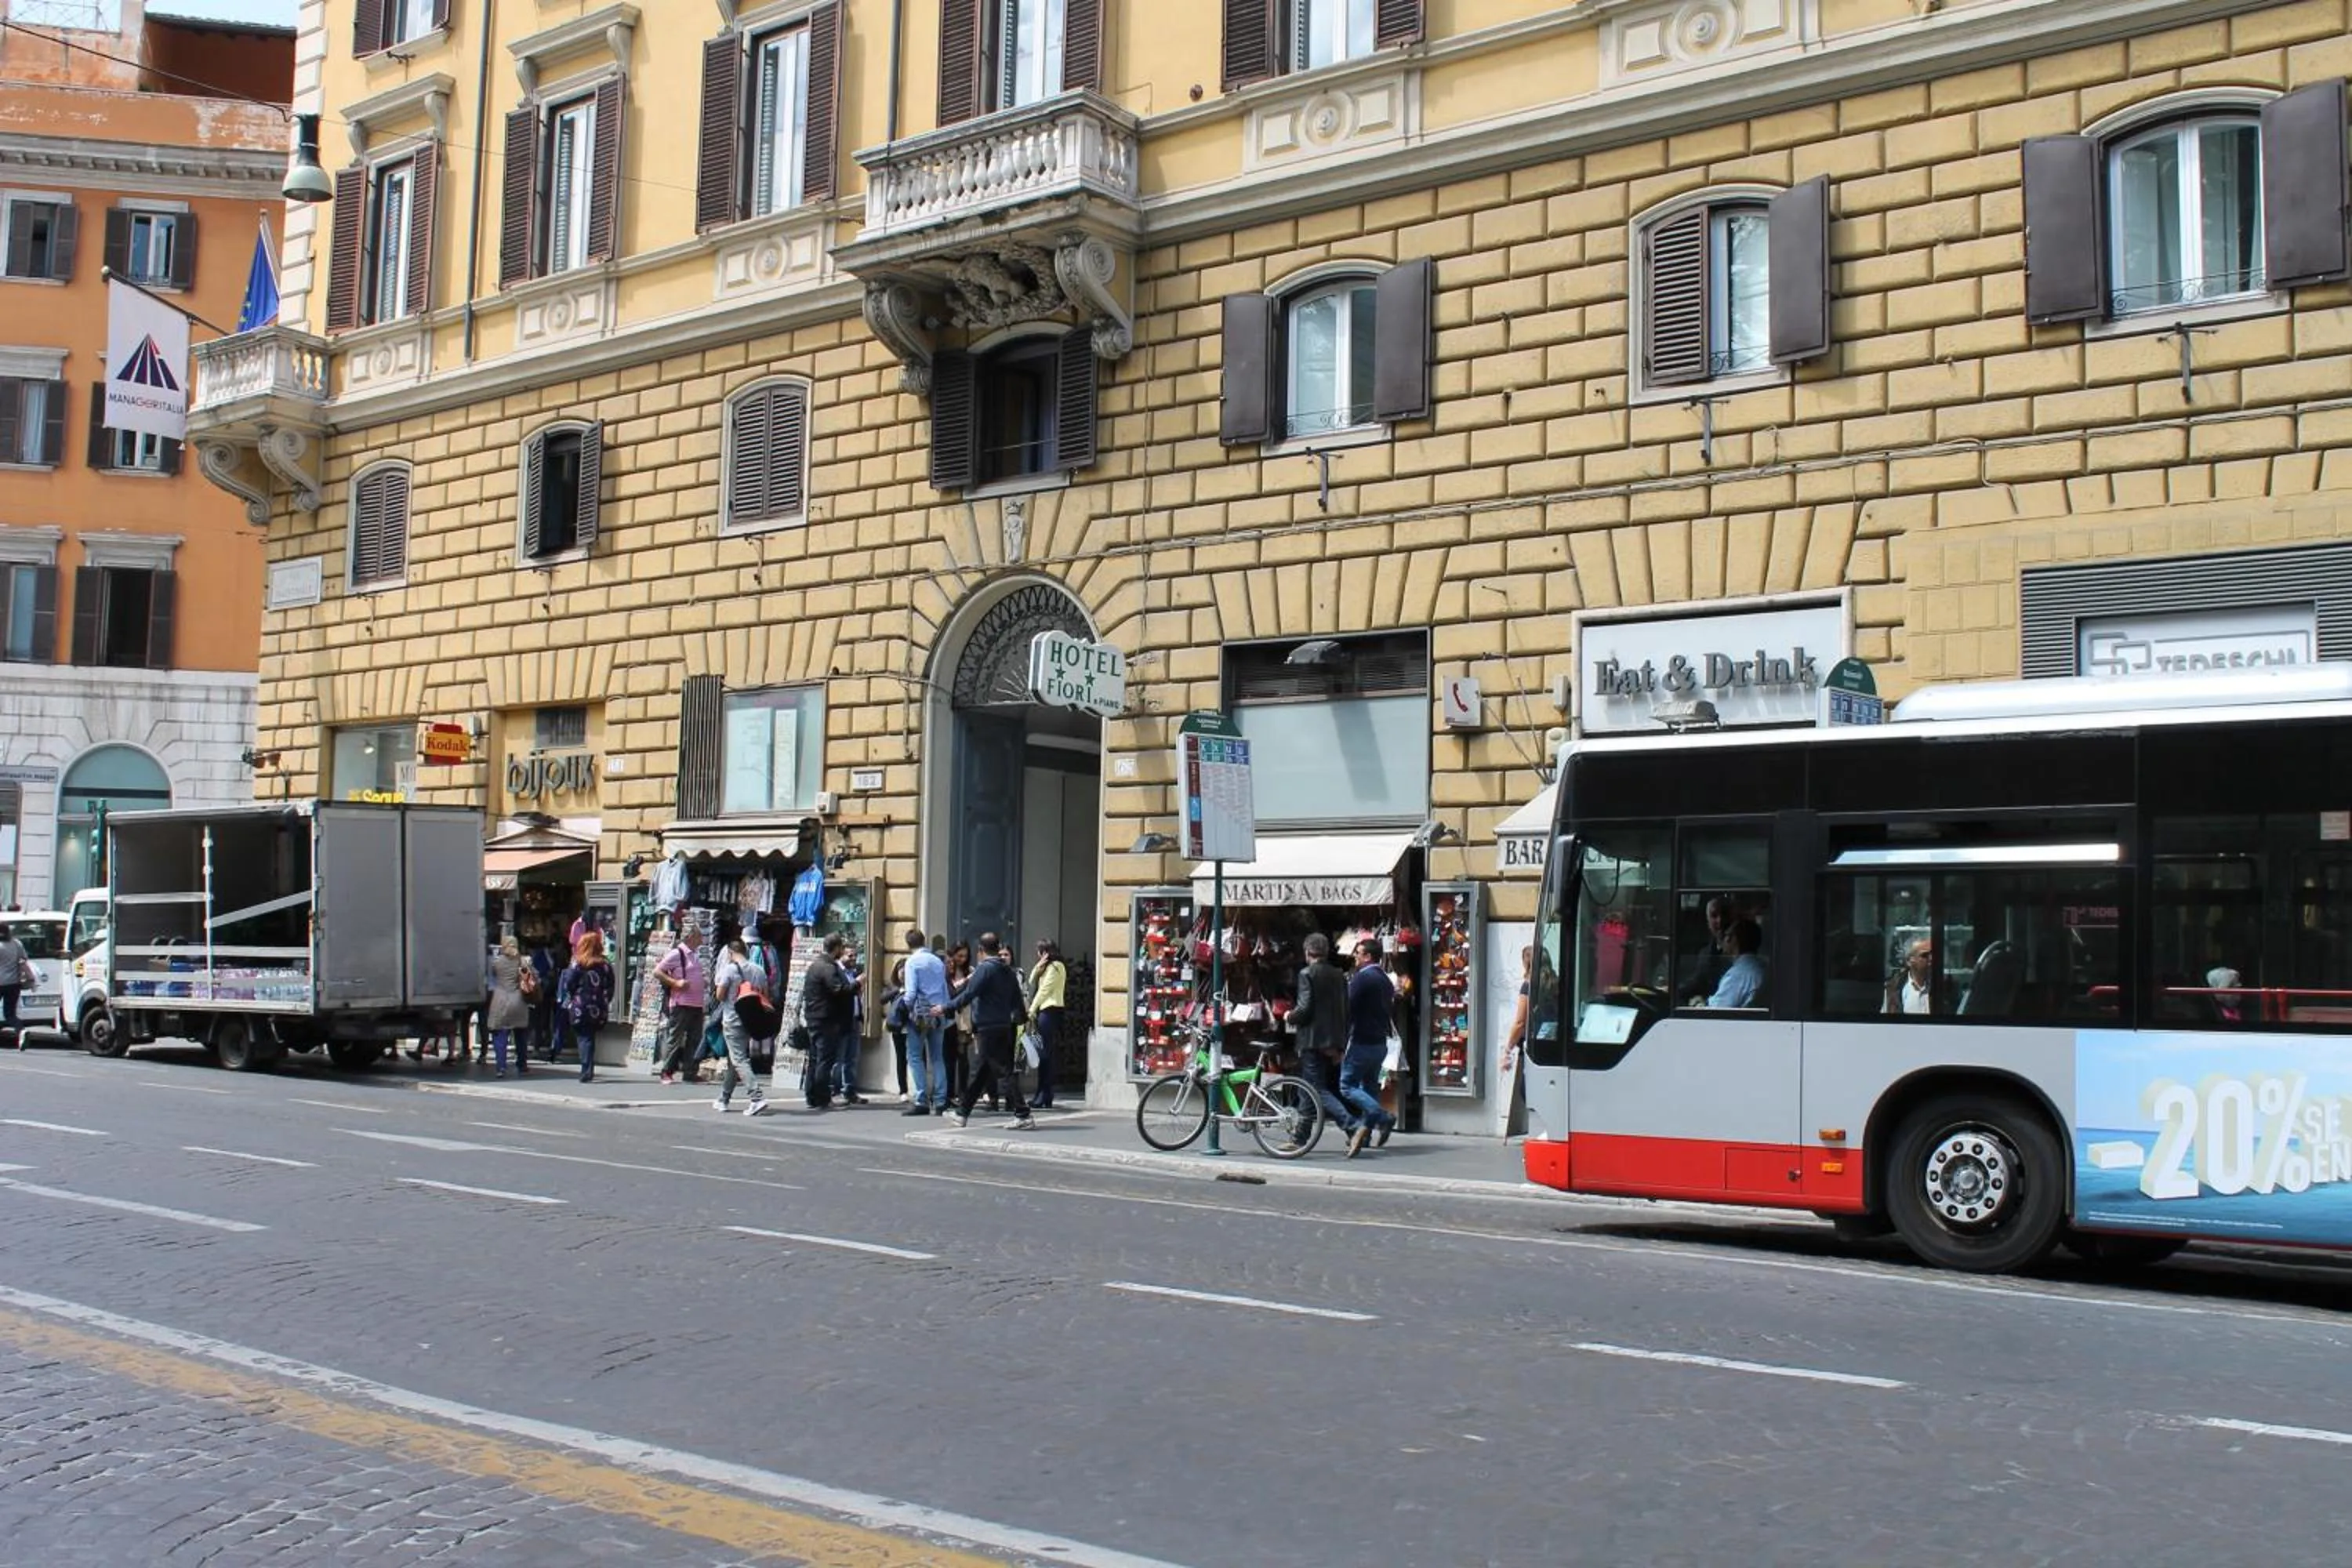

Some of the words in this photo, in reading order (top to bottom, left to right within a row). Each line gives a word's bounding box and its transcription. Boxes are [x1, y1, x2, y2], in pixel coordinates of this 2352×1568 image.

[1051, 640, 1121, 677] HOTEL
[1594, 659, 1655, 695] Eat
[1662, 654, 1697, 691] &
[1703, 646, 1817, 689] Drink
[1047, 678, 1091, 703] FIORI
[426, 736, 468, 753] Kodak
[506, 749, 595, 800] bijoux
[1505, 840, 1544, 865] BAR
[1320, 884, 1363, 900] BAGS
